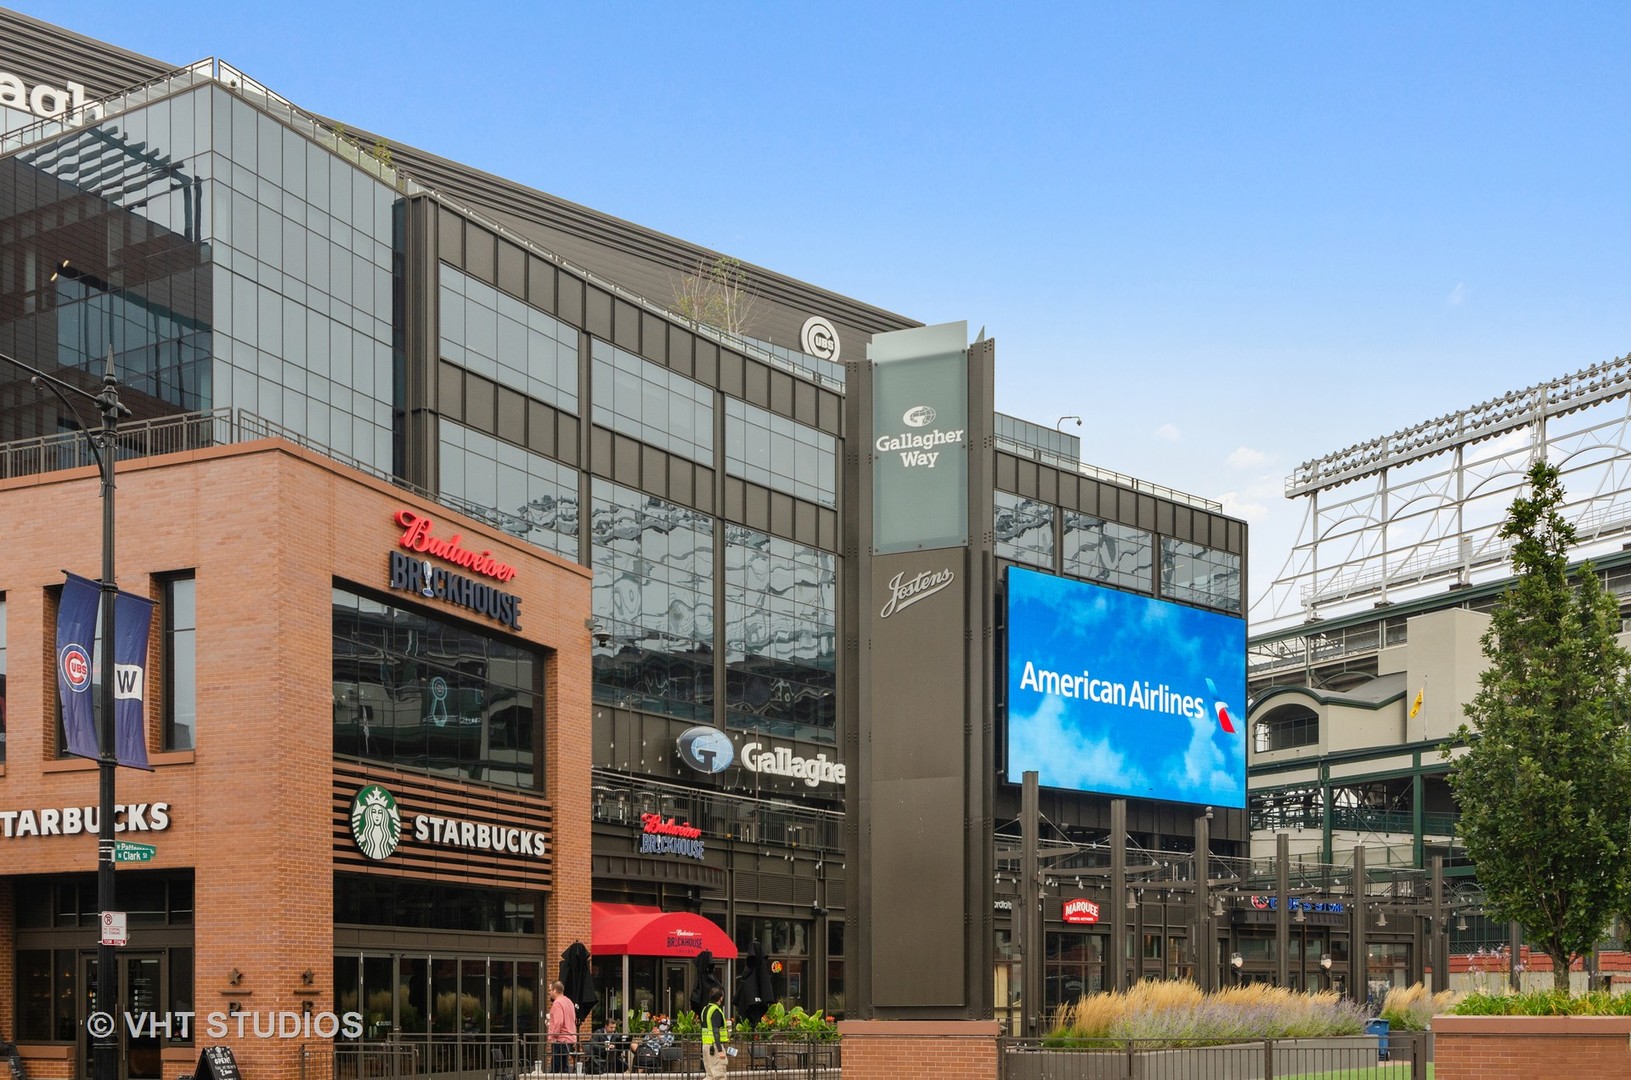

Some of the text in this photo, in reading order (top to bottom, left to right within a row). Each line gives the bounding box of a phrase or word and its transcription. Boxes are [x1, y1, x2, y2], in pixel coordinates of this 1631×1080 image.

[876, 429, 964, 451] Gallagher
[900, 450, 939, 468] Way
[394, 509, 517, 583] Budweiser
[389, 550, 522, 632] BRICKHOUSE
[880, 567, 954, 618] Jostens
[64, 650, 88, 686] CUBS
[116, 670, 138, 694] W
[1020, 661, 1204, 719] American Airlines
[415, 814, 546, 857] STARBUCKS
[641, 813, 702, 839] Budweiser
[122, 851, 142, 861] Clark
[642, 833, 705, 860] BRICKHOUSE
[1065, 901, 1099, 917] MARQUEE
